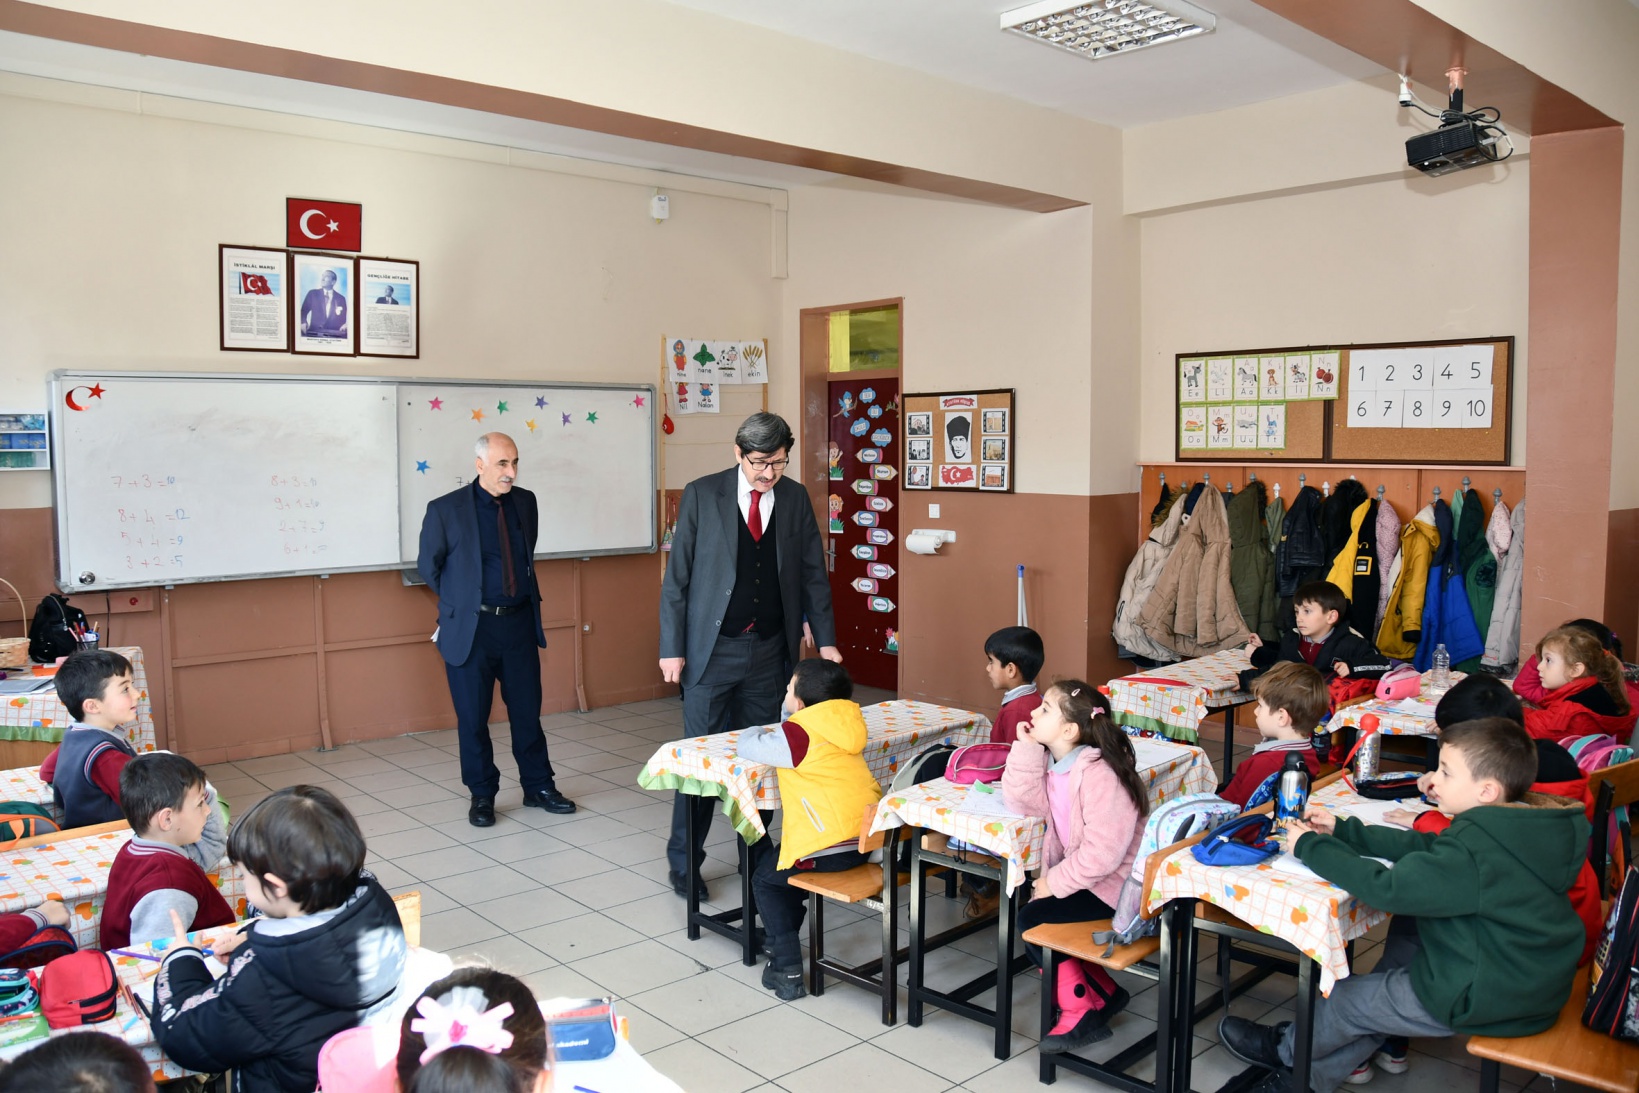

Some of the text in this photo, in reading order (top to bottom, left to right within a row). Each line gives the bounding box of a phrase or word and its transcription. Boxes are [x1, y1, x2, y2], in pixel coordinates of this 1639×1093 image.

[1358, 362, 1481, 382] 1 2 3 4 5
[1215, 388, 1220, 396] L
[1317, 384, 1324, 392] N
[1188, 389, 1193, 398] E
[1356, 400, 1486, 417] 6 7 8 9 10
[1188, 436, 1194, 444] O
